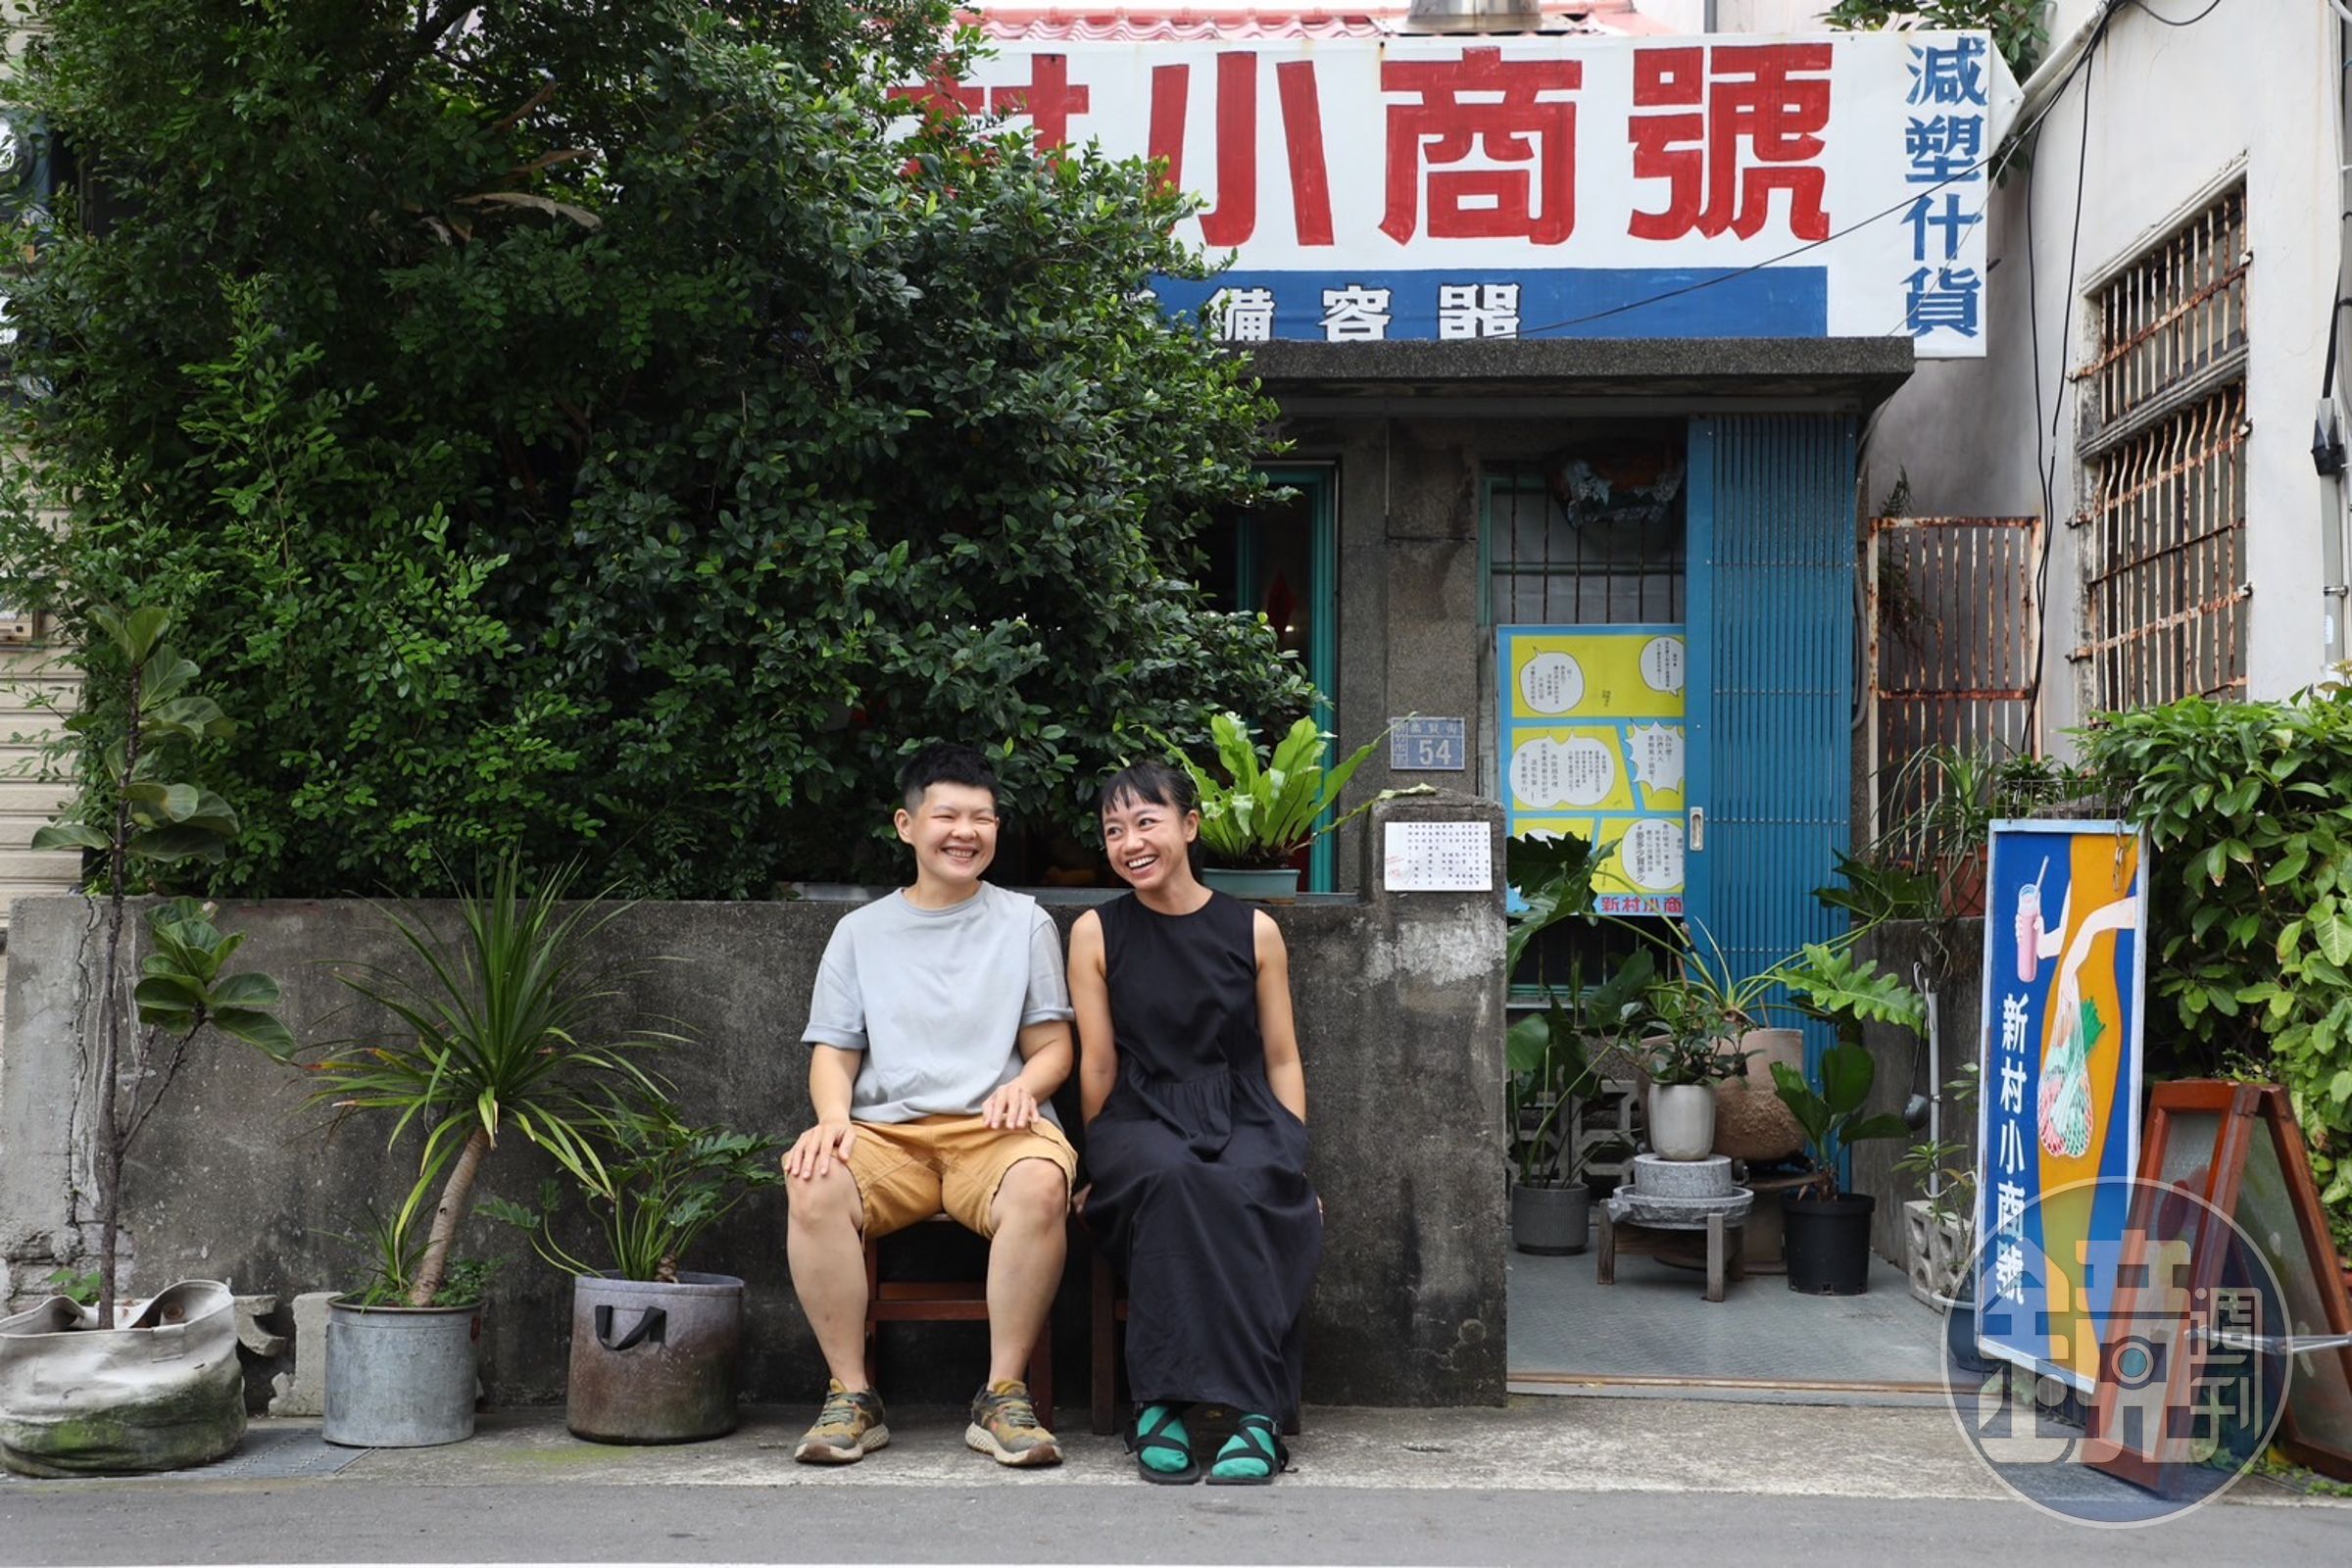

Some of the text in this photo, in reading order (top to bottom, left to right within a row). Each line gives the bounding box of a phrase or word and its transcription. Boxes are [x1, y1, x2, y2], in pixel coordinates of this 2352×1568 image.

[1905, 36, 1988, 340] 減塑什貨
[1135, 283, 1520, 341] 備容器
[1419, 739, 1451, 765] 54
[1601, 896, 1683, 913] 新村小商
[1996, 992, 2029, 1306] 新村小商號
